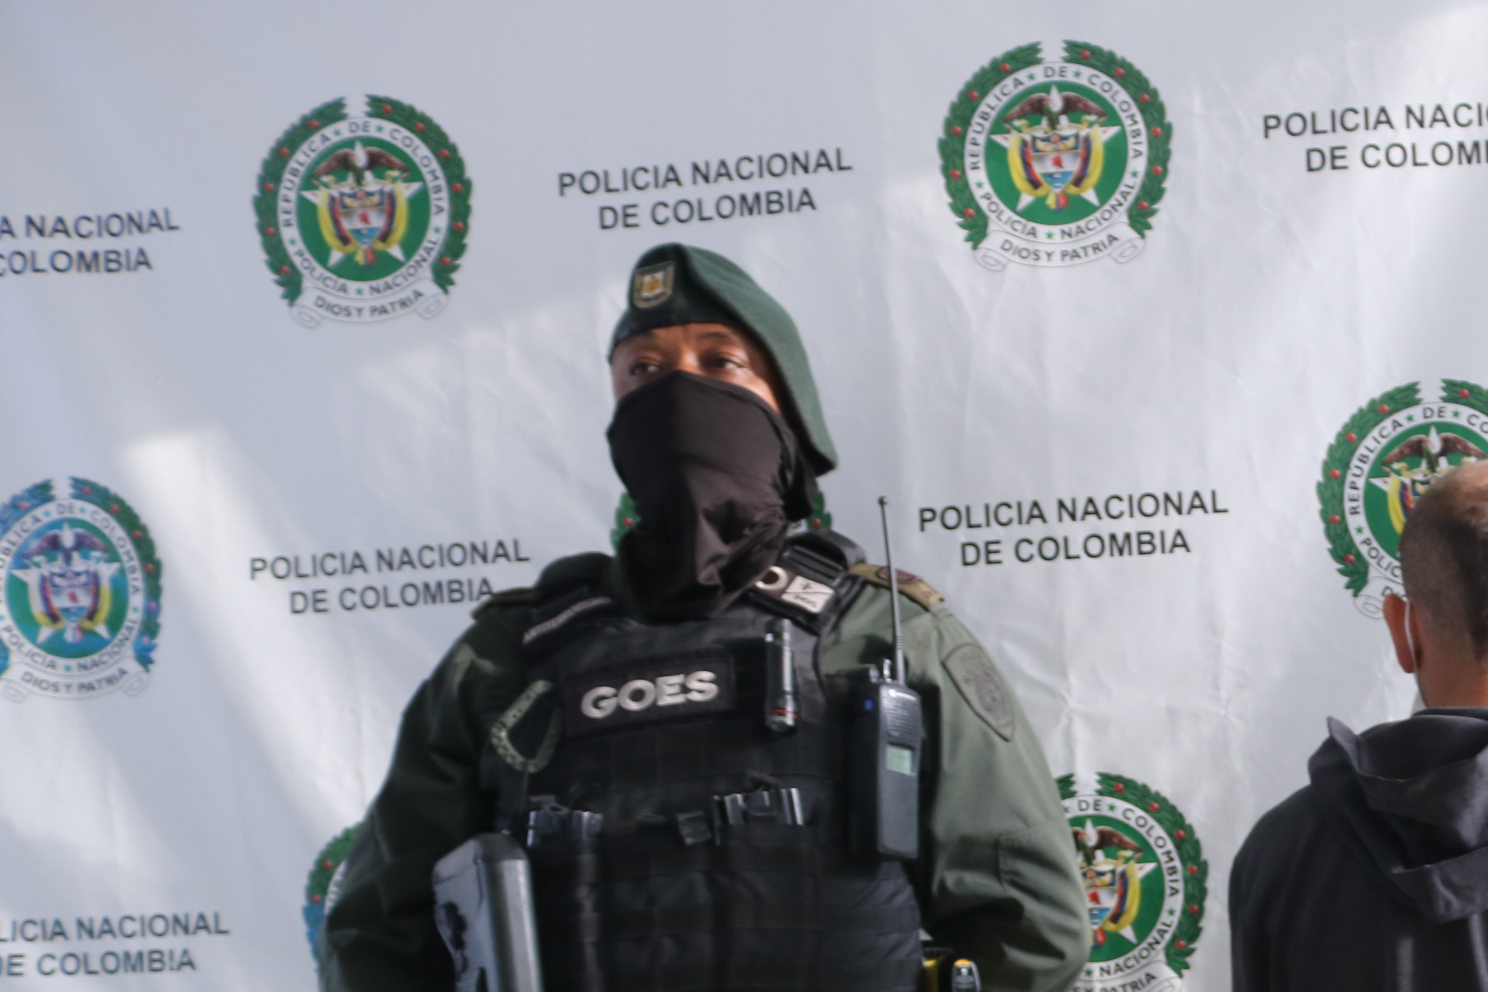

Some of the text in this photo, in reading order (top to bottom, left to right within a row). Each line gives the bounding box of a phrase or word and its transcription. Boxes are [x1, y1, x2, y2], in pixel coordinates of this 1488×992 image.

[1044, 66, 1068, 78] DE
[1087, 73, 1144, 159] COLOMBIA
[1262, 105, 1396, 140] POLICIA
[558, 148, 853, 197] POLICIA NACIONAL
[1305, 145, 1349, 173] DE
[26, 208, 181, 240] NACIONAL
[598, 187, 817, 231] DE COLOMBIA
[1060, 181, 1137, 239] NACIONAL
[1060, 233, 1120, 262] PATRIA
[1423, 407, 1447, 419] DE
[918, 489, 1230, 533] POLICIA NACIONAL
[250, 538, 531, 580] POLICIA NACIONAL
[960, 528, 1192, 567] DE COLOMBIA
[290, 577, 494, 615] DE COLOMBIA
[580, 670, 720, 719] GOES
[1078, 800, 1180, 897] DE COLOMBIA
[76, 912, 230, 940] NACIONAL
[36, 948, 197, 977] COLOMBIA
[1100, 919, 1174, 977] NACIONAL
